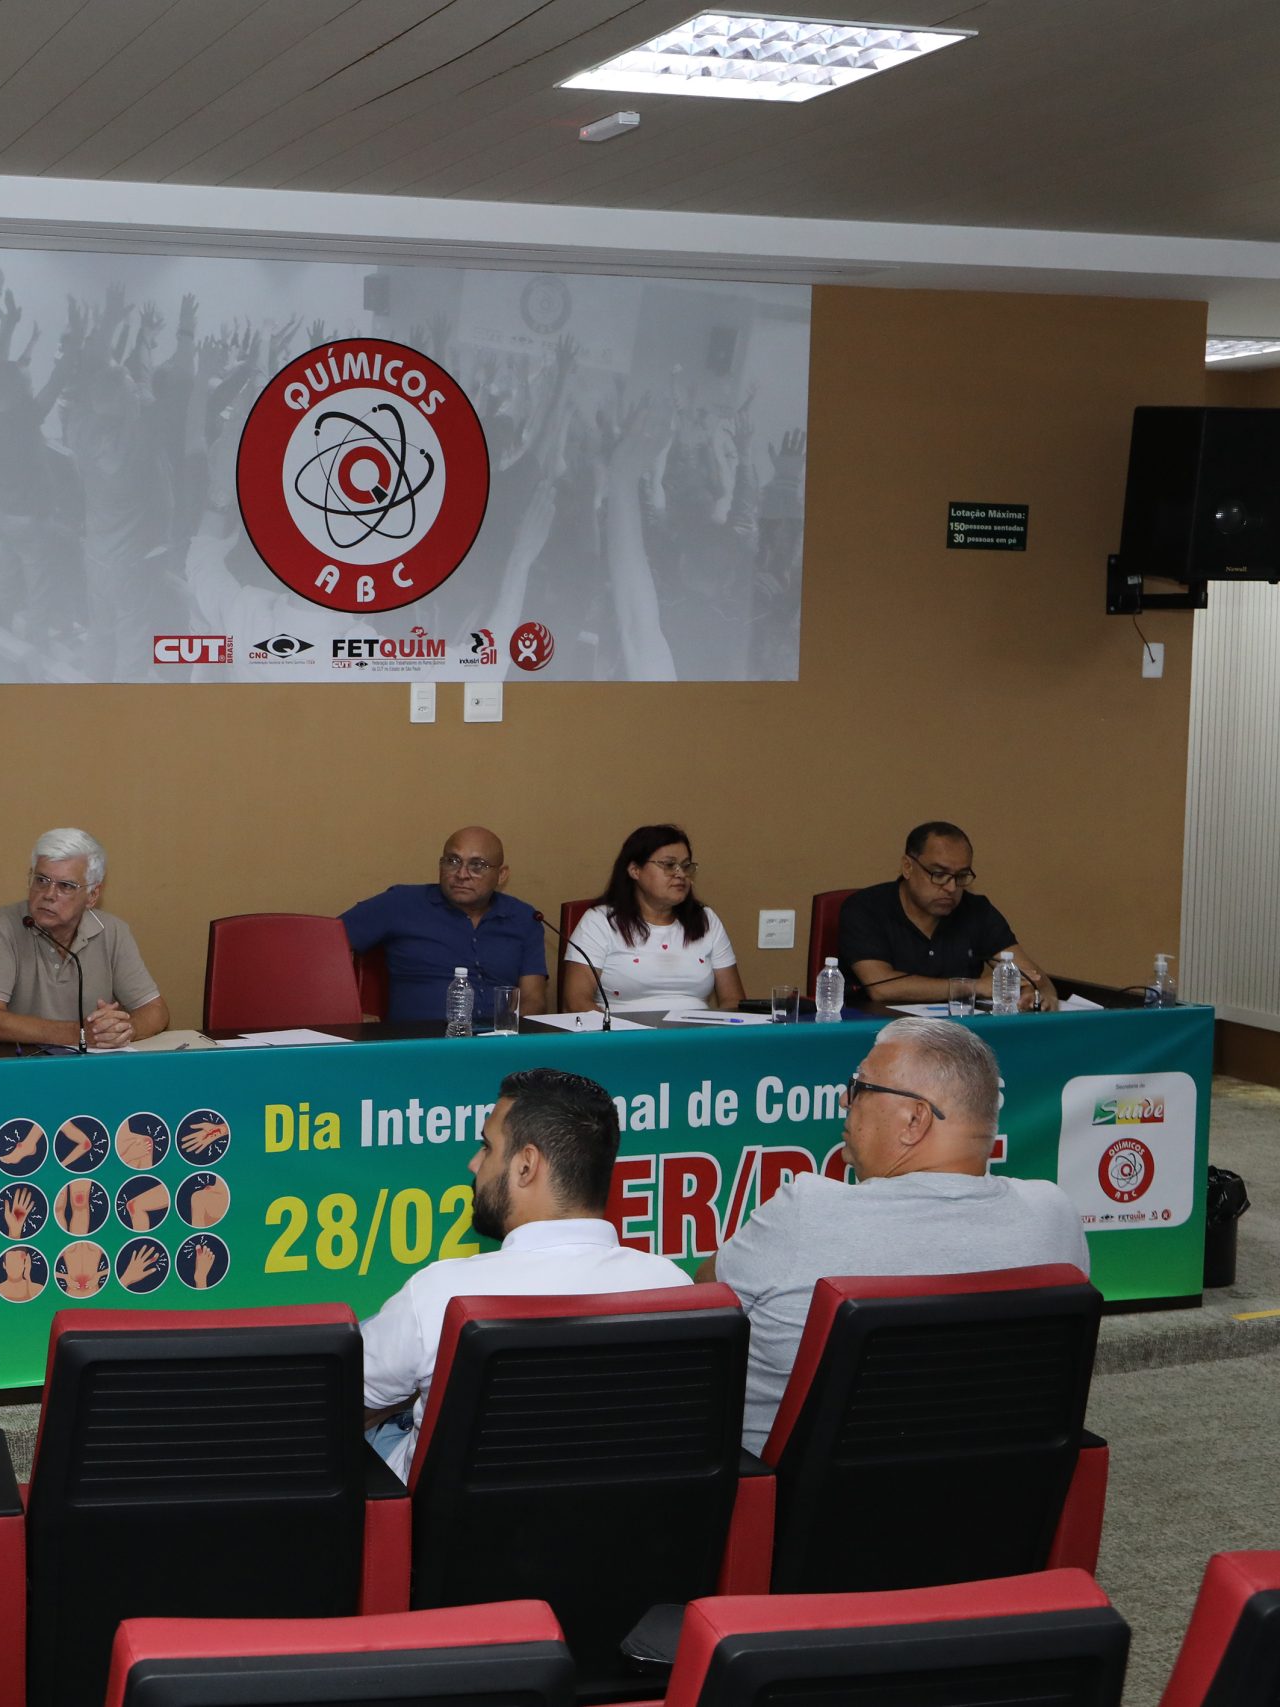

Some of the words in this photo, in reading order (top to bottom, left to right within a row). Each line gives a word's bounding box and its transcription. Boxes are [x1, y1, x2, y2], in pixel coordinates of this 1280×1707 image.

[284, 348, 446, 415] QUÍMICOS
[951, 508, 986, 518] Lotação
[988, 510, 1026, 519] Máxima:
[953, 533, 964, 543] 30
[155, 638, 224, 662] CUT
[332, 639, 445, 659] FETQUIM
[265, 1102, 341, 1153] Dia
[688, 1080, 738, 1129] de
[1109, 1141, 1145, 1157] QUÍMICOS
[265, 1185, 479, 1276] 28/02
